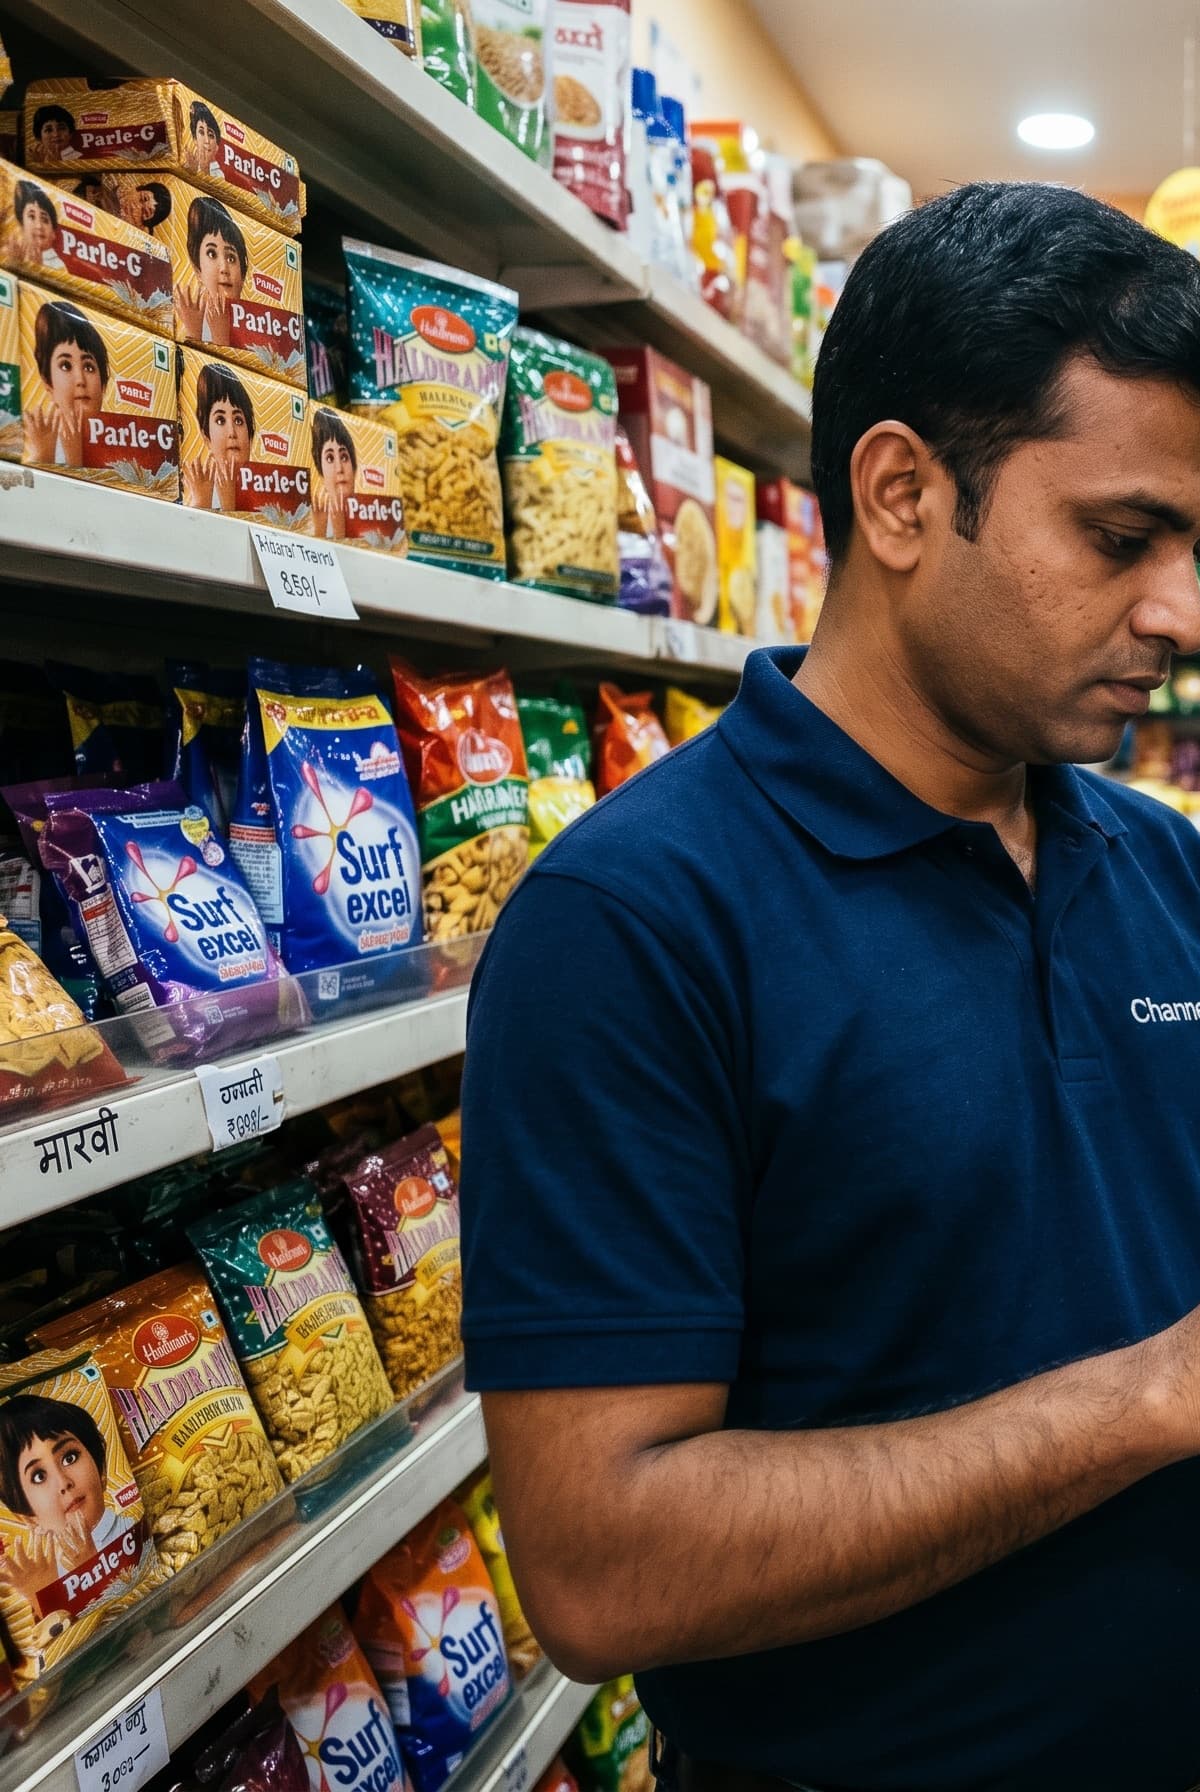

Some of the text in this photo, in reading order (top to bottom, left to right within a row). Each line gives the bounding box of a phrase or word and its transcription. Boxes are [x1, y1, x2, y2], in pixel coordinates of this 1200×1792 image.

[81, 126, 155, 148] Parle-G
[224, 145, 281, 188] Parle-G
[61, 229, 142, 277] Parle-G
[232, 304, 300, 337] Parle-G
[120, 384, 151, 401] PARLE
[88, 418, 174, 452] Parle-G
[240, 467, 309, 496] Parle-G
[347, 497, 402, 523] Parle-G
[336, 826, 406, 884] Surf
[167, 886, 245, 931] Surf
[346, 883, 411, 924] excel
[197, 923, 261, 963] excel
[62, 1532, 136, 1601] Parle-G
[439, 1600, 499, 1679] Surf
[319, 1698, 388, 1785] Surf
